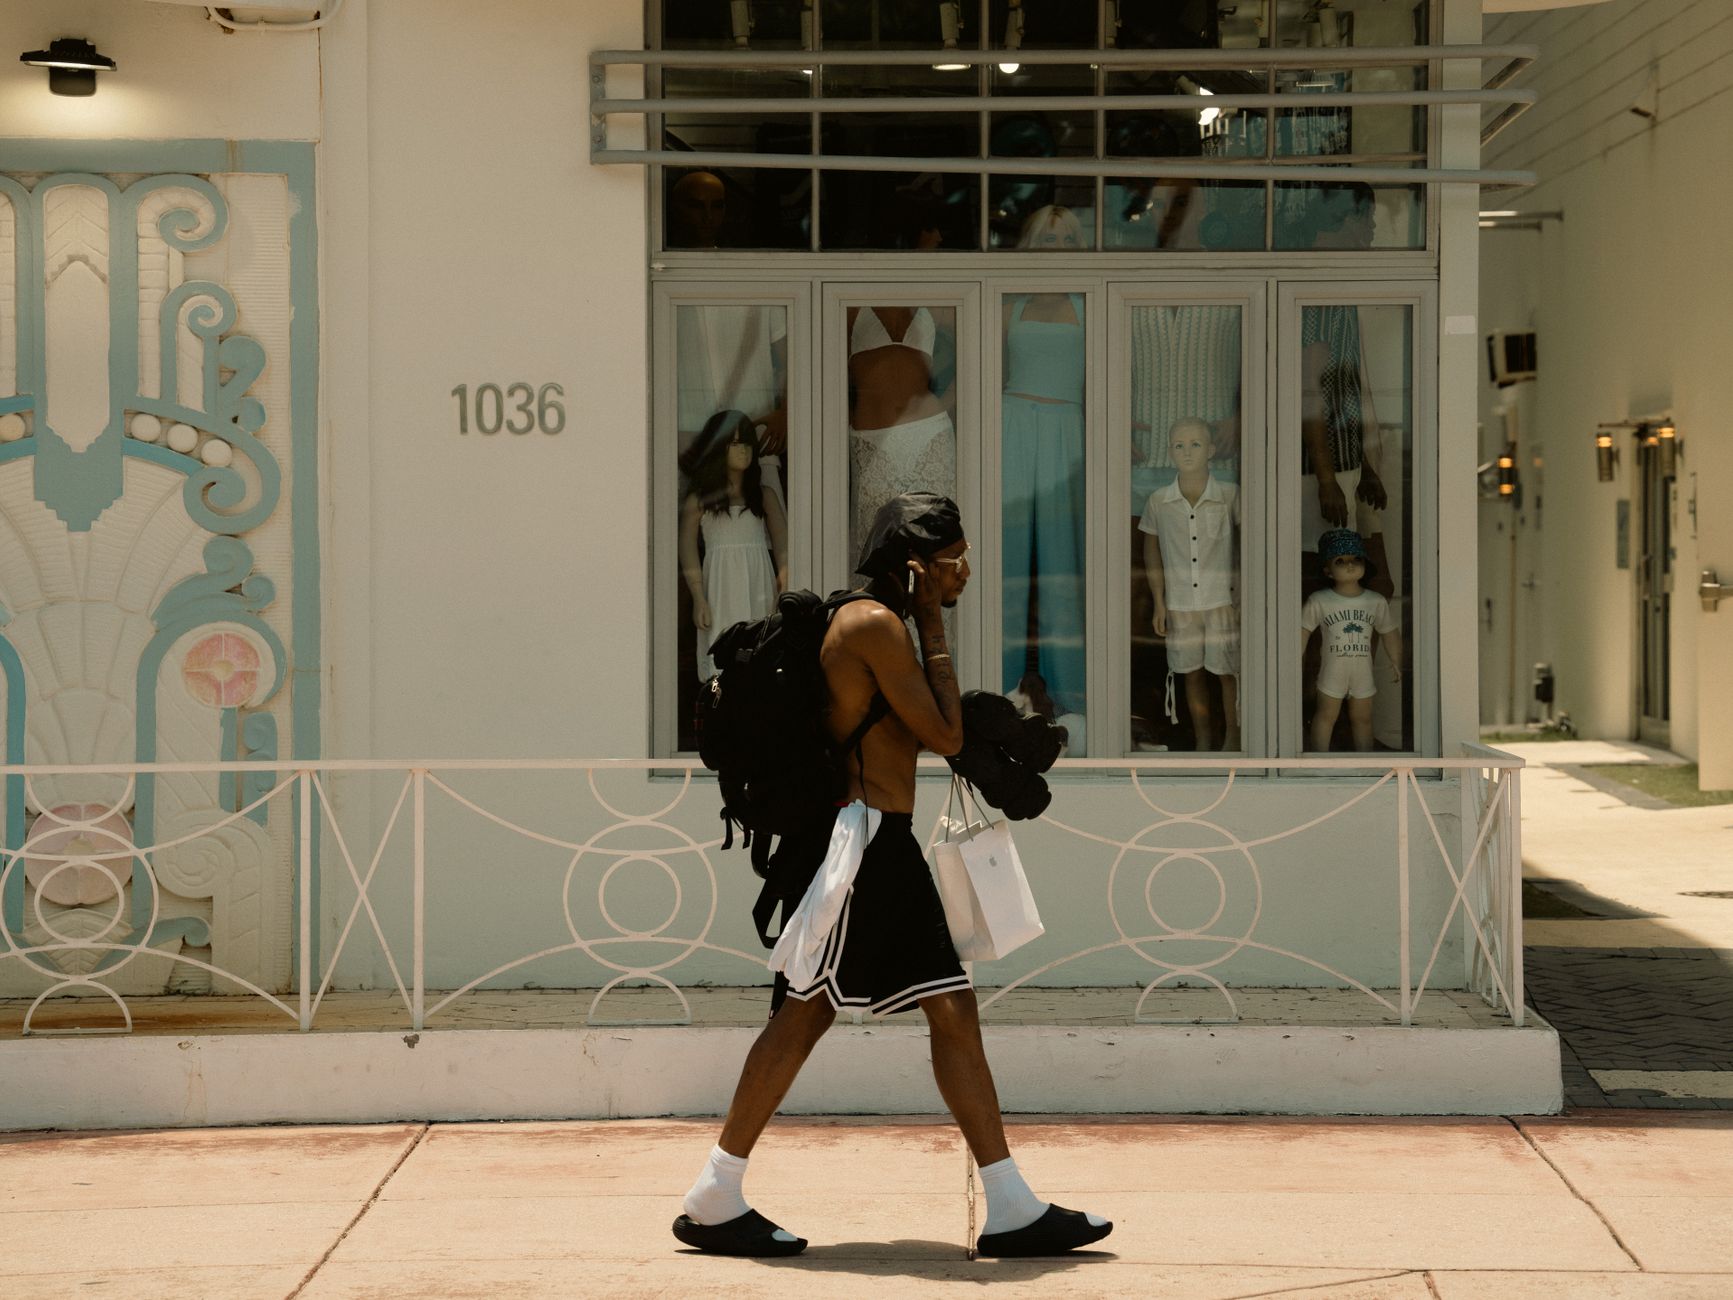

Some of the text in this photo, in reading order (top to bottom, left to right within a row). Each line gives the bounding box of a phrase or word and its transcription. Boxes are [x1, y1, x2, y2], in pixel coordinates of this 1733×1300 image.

[451, 382, 566, 436] 1036
[1323, 609, 1376, 628] MIAMI BEAC
[1329, 643, 1370, 653] FLORID
